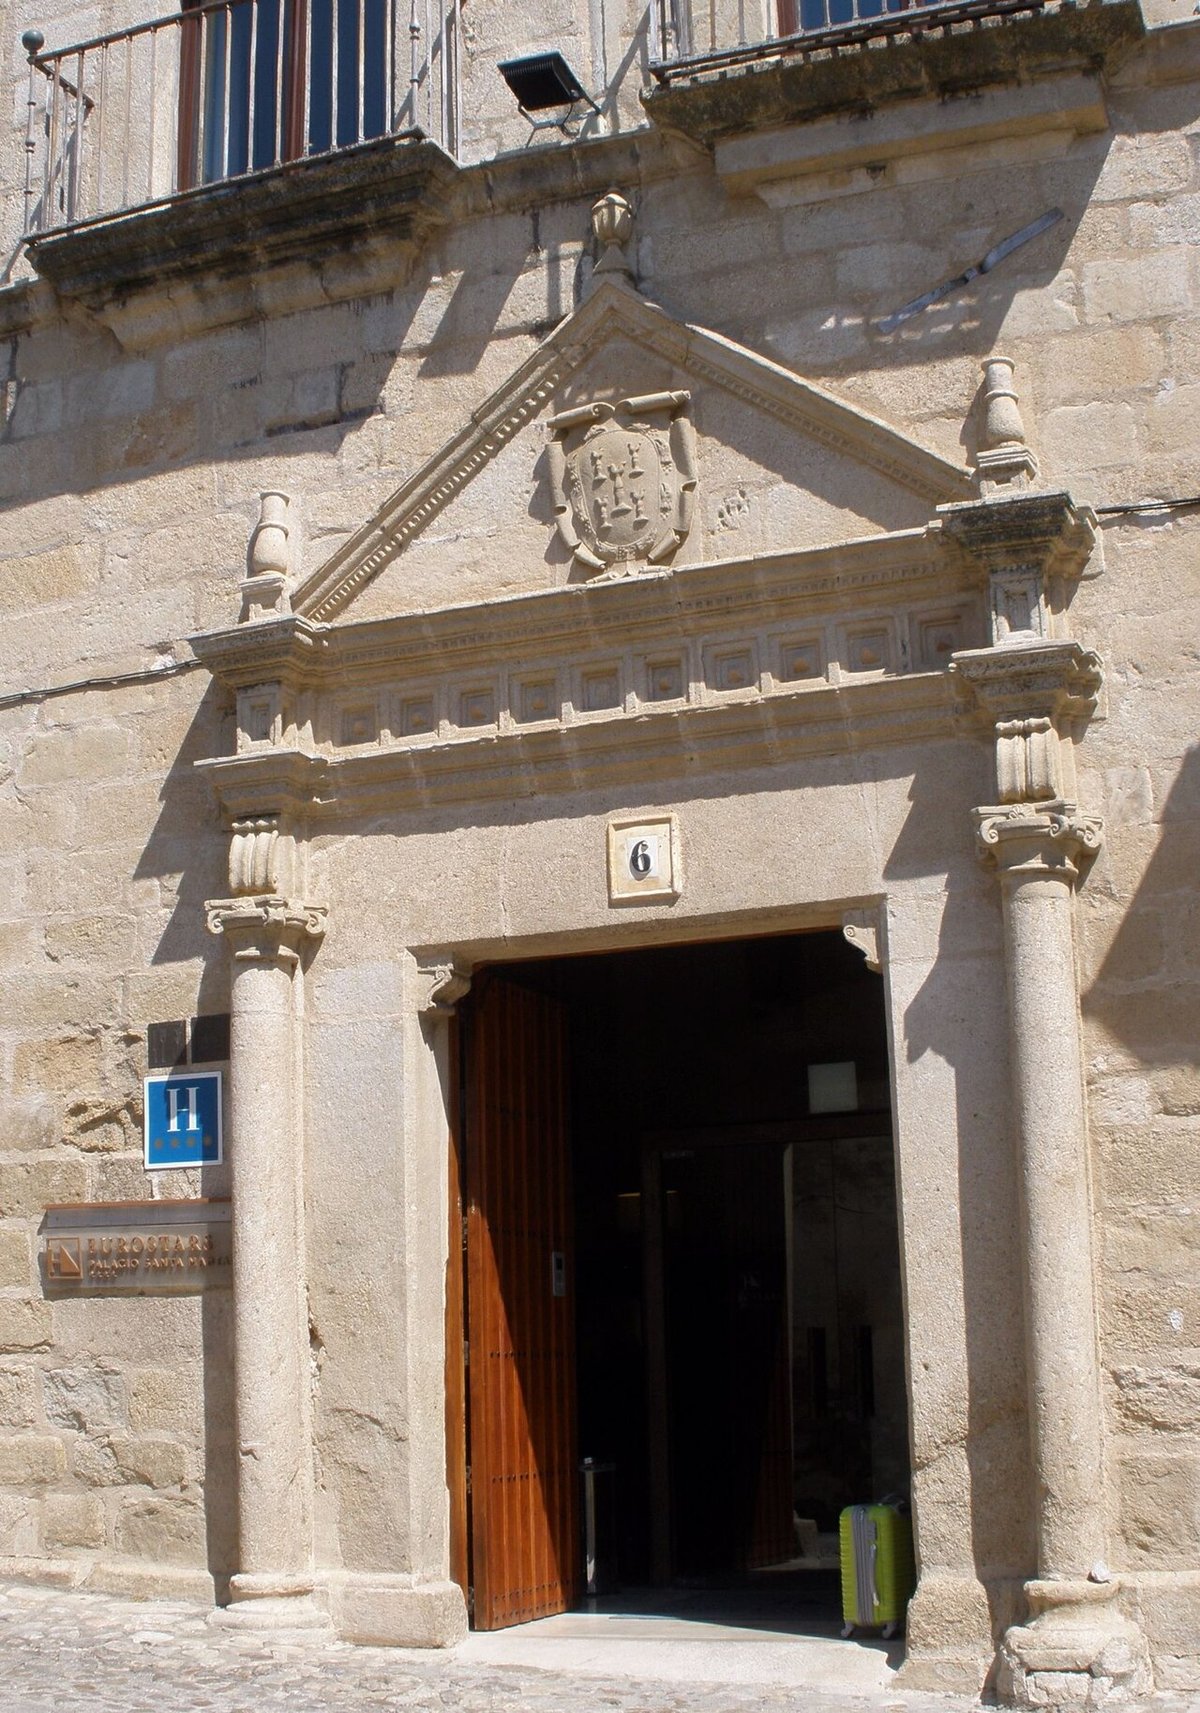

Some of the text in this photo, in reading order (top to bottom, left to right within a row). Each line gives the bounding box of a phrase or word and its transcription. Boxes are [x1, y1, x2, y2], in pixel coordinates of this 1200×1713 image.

[629, 840, 651, 875] 6
[166, 1086, 200, 1133] H
[87, 1233, 214, 1254] EUROSTARS
[89, 1257, 140, 1269] PALACIO
[145, 1256, 185, 1268] SANTA
